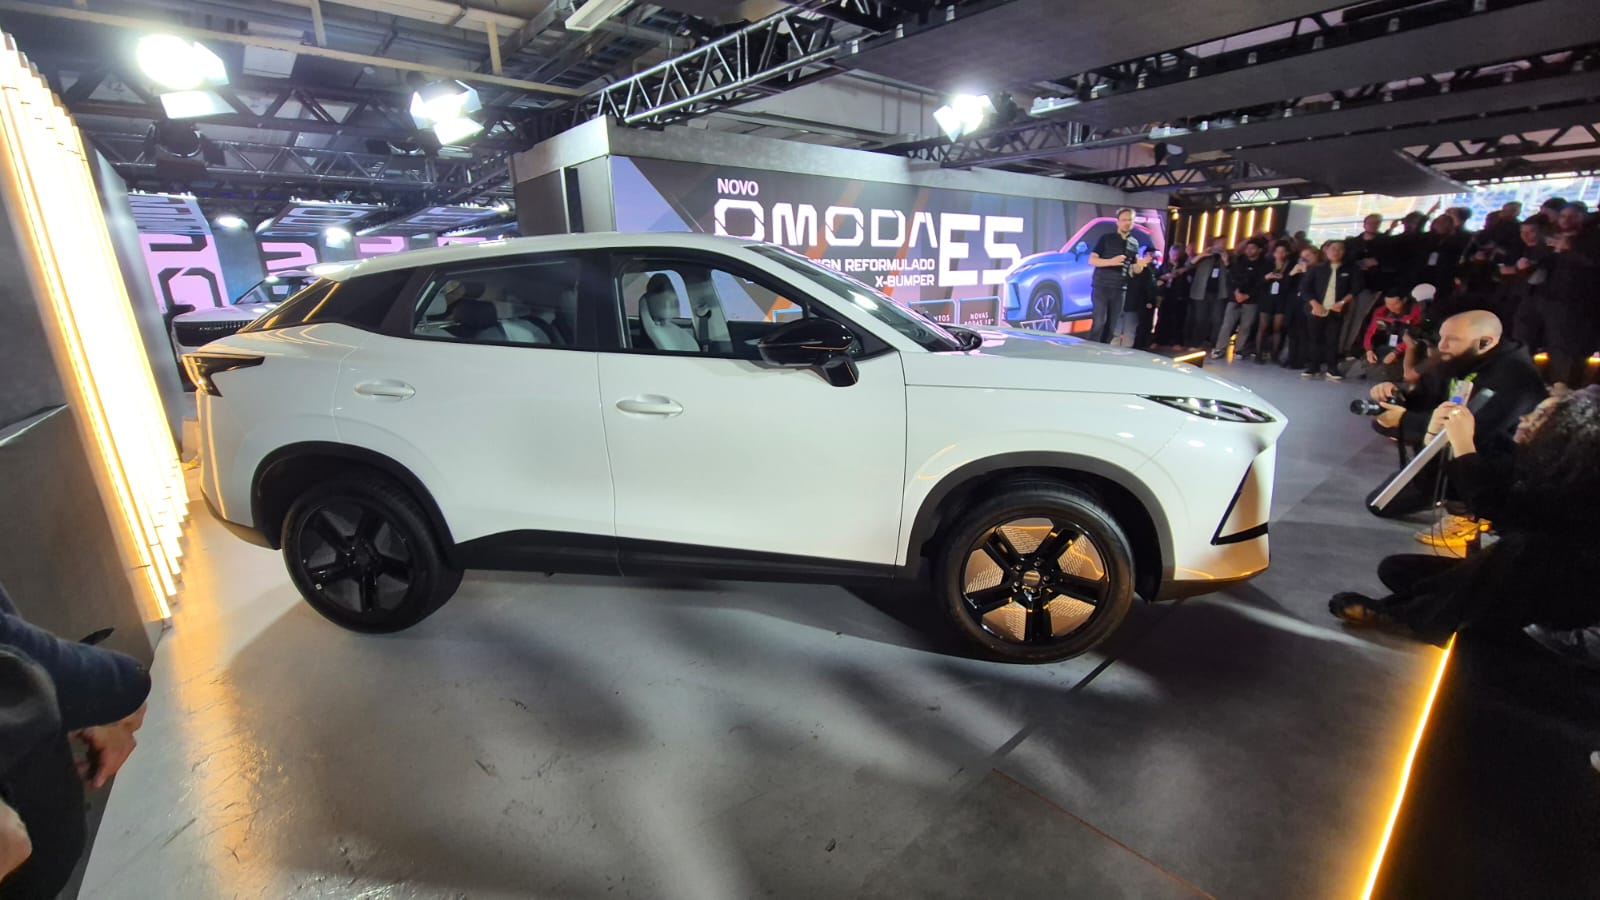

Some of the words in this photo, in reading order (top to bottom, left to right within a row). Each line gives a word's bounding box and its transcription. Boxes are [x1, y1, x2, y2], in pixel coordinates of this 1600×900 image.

[717, 177, 760, 197] NOVO
[844, 258, 936, 272] REFORMULADO
[875, 274, 936, 288] X-BUMPER
